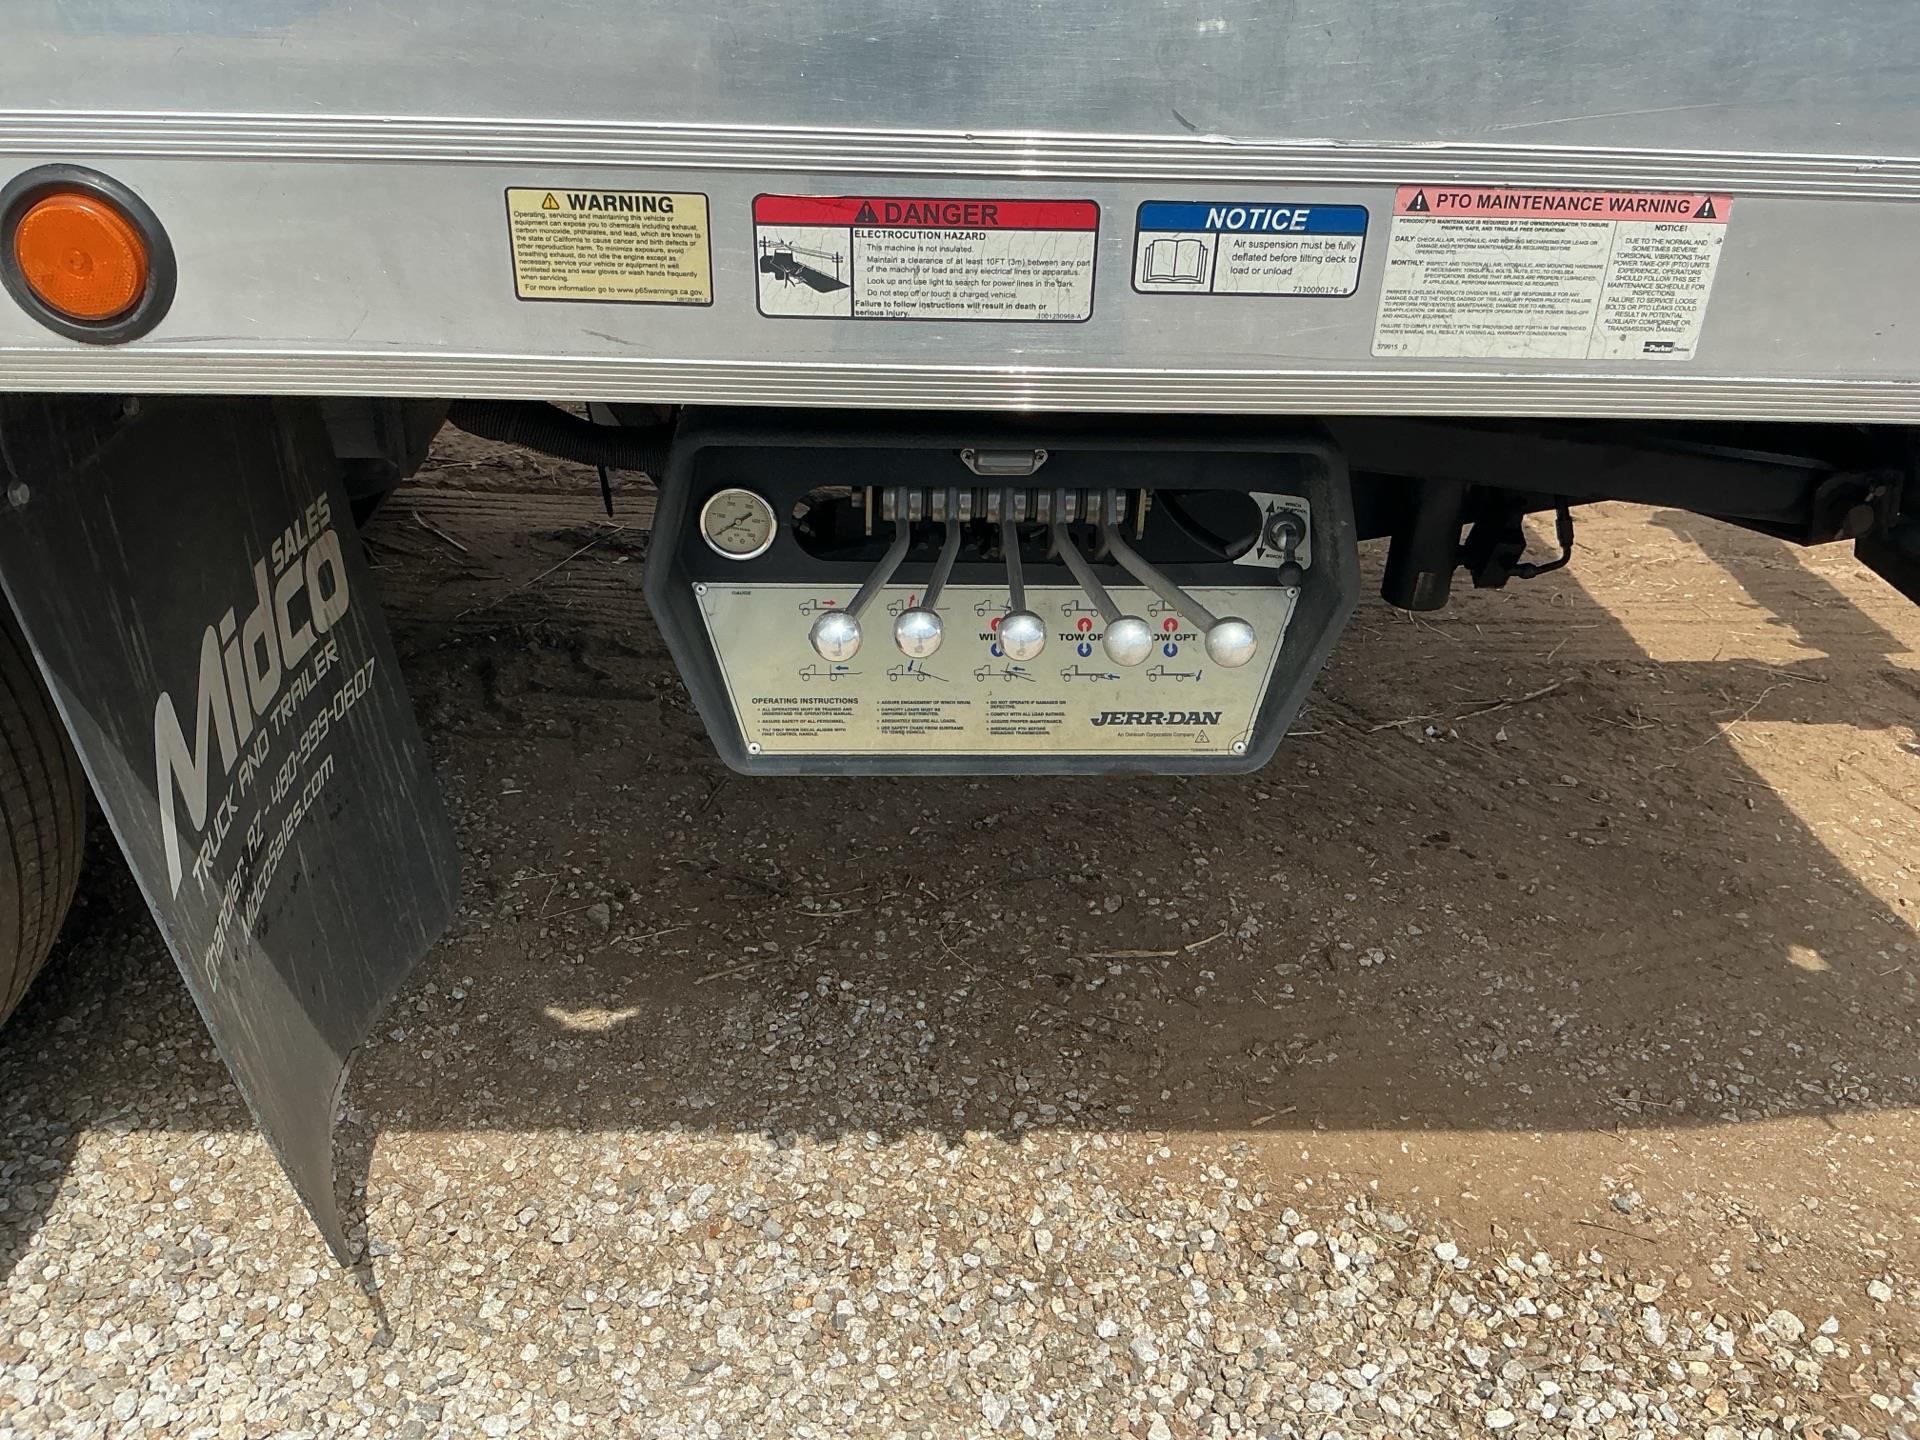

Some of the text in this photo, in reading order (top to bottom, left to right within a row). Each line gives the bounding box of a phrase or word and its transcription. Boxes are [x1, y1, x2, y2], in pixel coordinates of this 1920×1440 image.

[567, 194, 673, 213] WARNING
[1436, 194, 1690, 214] PTO MAINTENANCE WARNING
[513, 211, 546, 219] Operating,
[549, 212, 576, 220] servicing
[592, 213, 628, 221] maintaining
[884, 202, 998, 225] DANGER
[1205, 207, 1309, 230] NOTICE
[854, 230, 985, 239] ELECTROCUTION HAZARD
[1233, 239, 1355, 251] Air suspension must be fully
[1008, 258, 1025, 266] (3m)
[1232, 253, 1266, 261] deflated
[1299, 254, 1322, 264] tilting
[1348, 255, 1357, 263] to
[1042, 268, 1080, 276] apparatus.
[1230, 266, 1248, 274] load
[886, 309, 909, 317] injury.
[272, 491, 330, 577] SALES
[1058, 633, 1084, 641] TOW
[1174, 633, 1198, 641] OPT
[154, 530, 349, 901] Midco
[1090, 711, 1222, 725] JERR-DAN
[192, 638, 340, 892] TRUCK AND TRAILER
[246, 809, 264, 863] AZ
[270, 656, 375, 804] 480-999-0607
[241, 754, 334, 944] Midcosales.com
